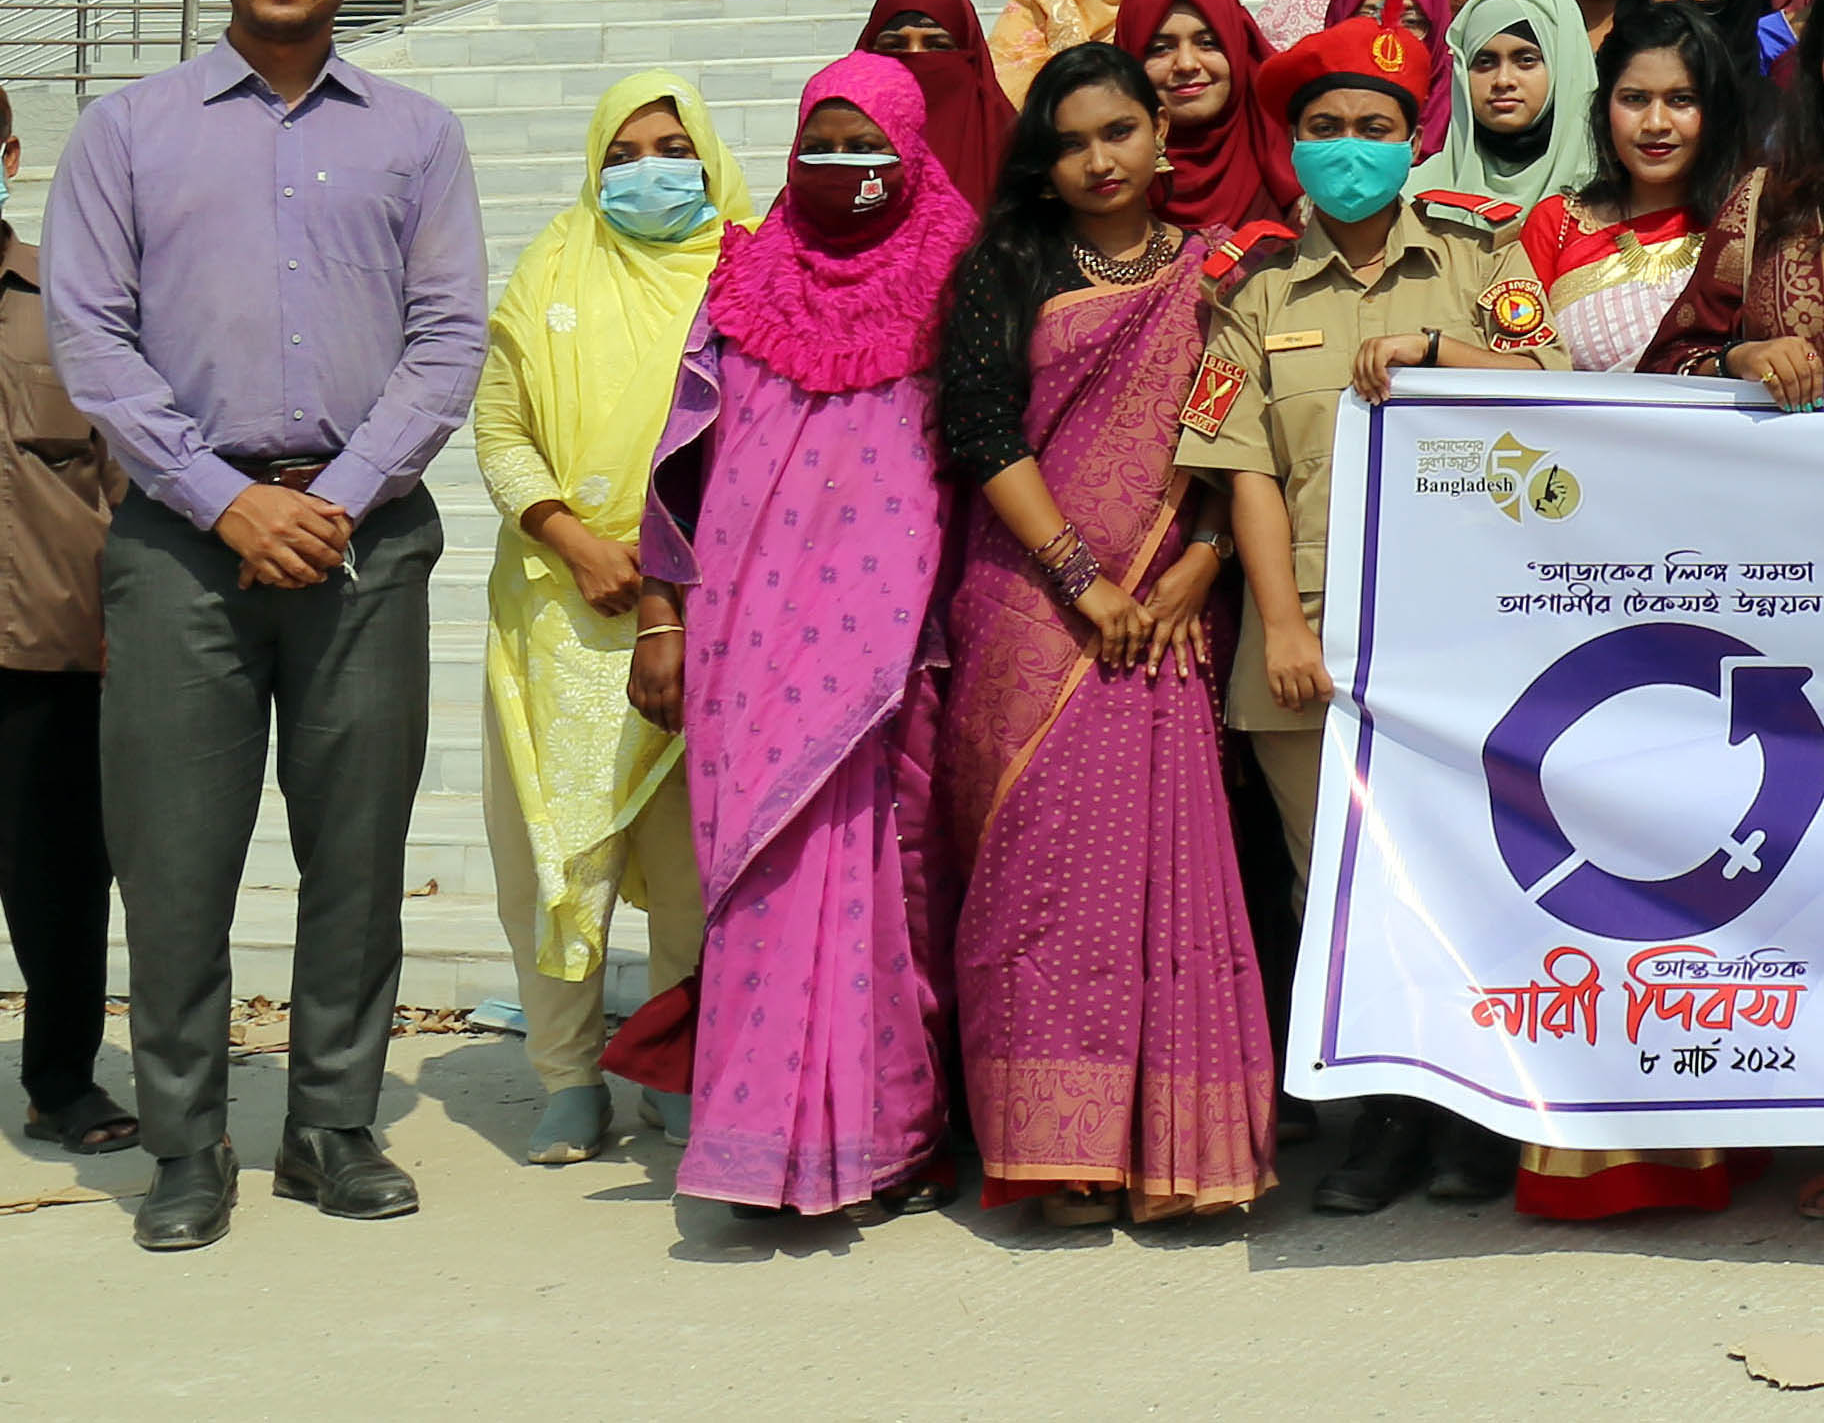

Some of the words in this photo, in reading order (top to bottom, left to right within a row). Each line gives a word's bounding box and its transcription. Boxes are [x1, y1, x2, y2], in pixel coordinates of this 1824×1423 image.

[1416, 477, 1513, 496] Bangladesh
[1663, 550, 1729, 585] লিঙ্গ
[1738, 561, 1815, 582] সমতা
[1496, 582, 1612, 617] আগামীর
[1623, 588, 1721, 616] টেকসই
[1467, 946, 1604, 1047] নারী
[1623, 944, 1808, 1045] দিবস
[1672, 1038, 1723, 1077] মার্চ
[1731, 1047, 1797, 1074] ২০২২
